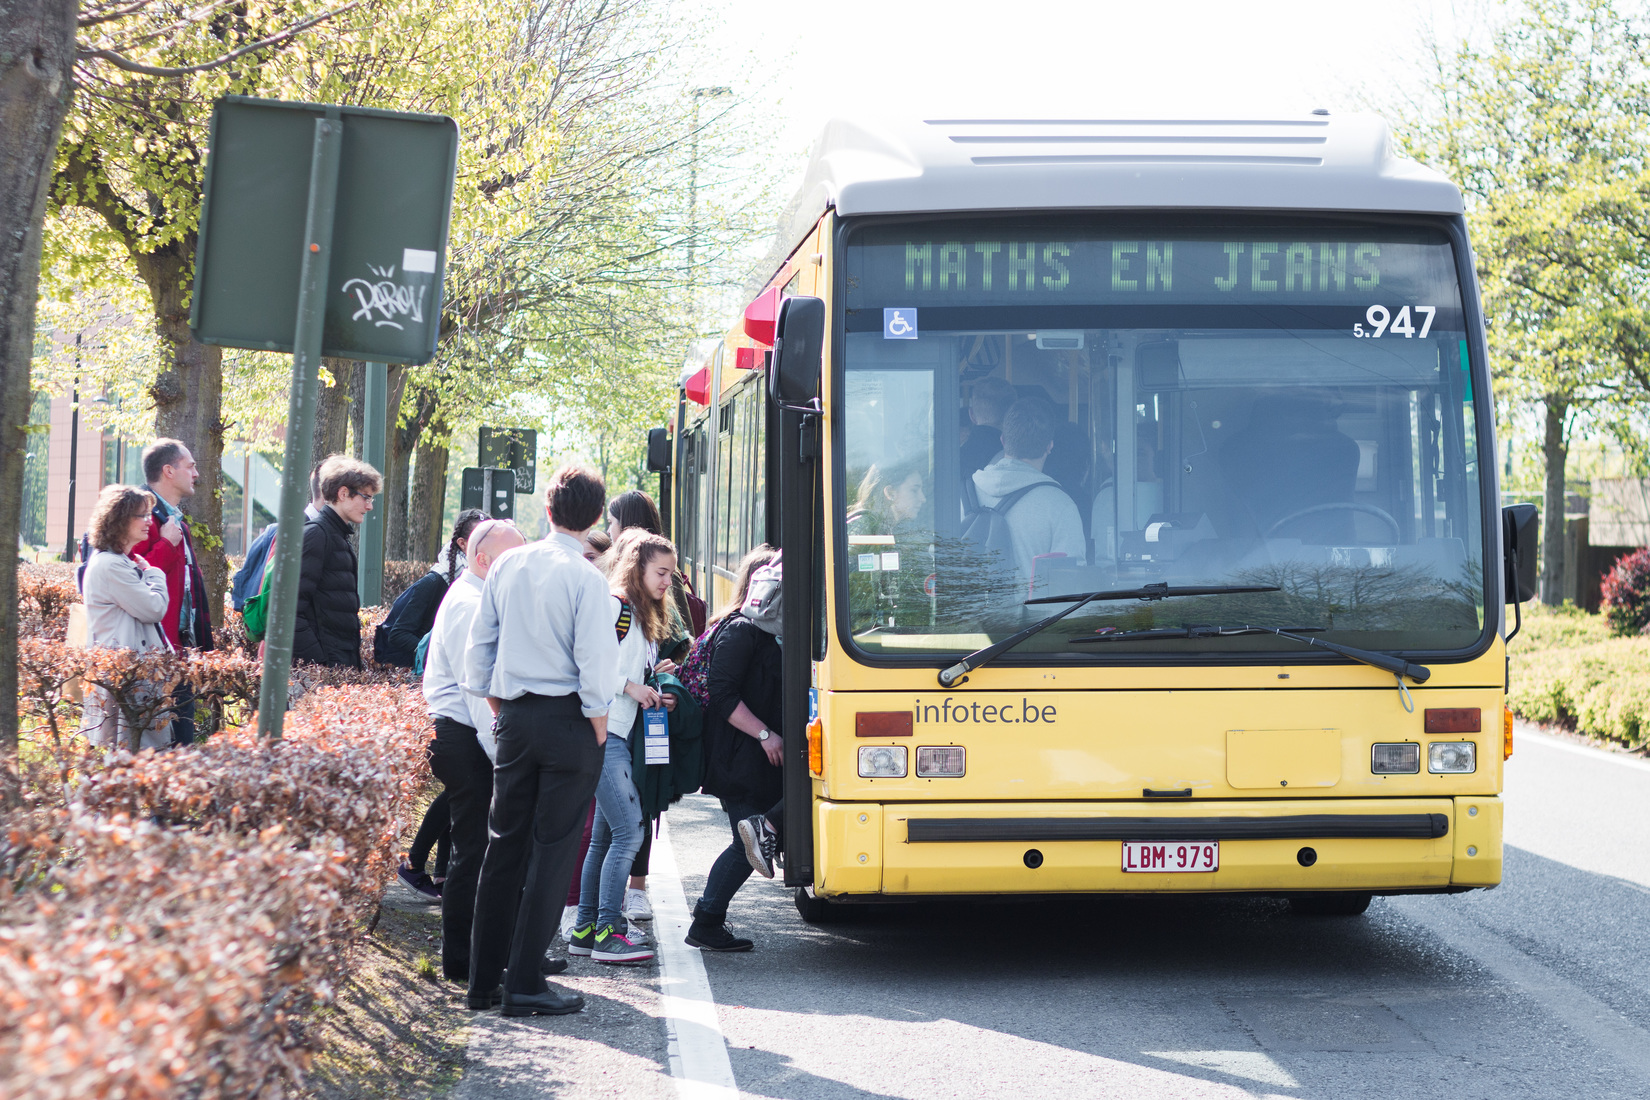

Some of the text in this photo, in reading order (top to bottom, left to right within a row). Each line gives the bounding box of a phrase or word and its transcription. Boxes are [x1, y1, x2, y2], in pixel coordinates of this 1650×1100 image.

[905, 241, 1380, 291] MATHS EN JEANS
[1353, 304, 1437, 338] 5.947
[915, 697, 1057, 723] infotec.be
